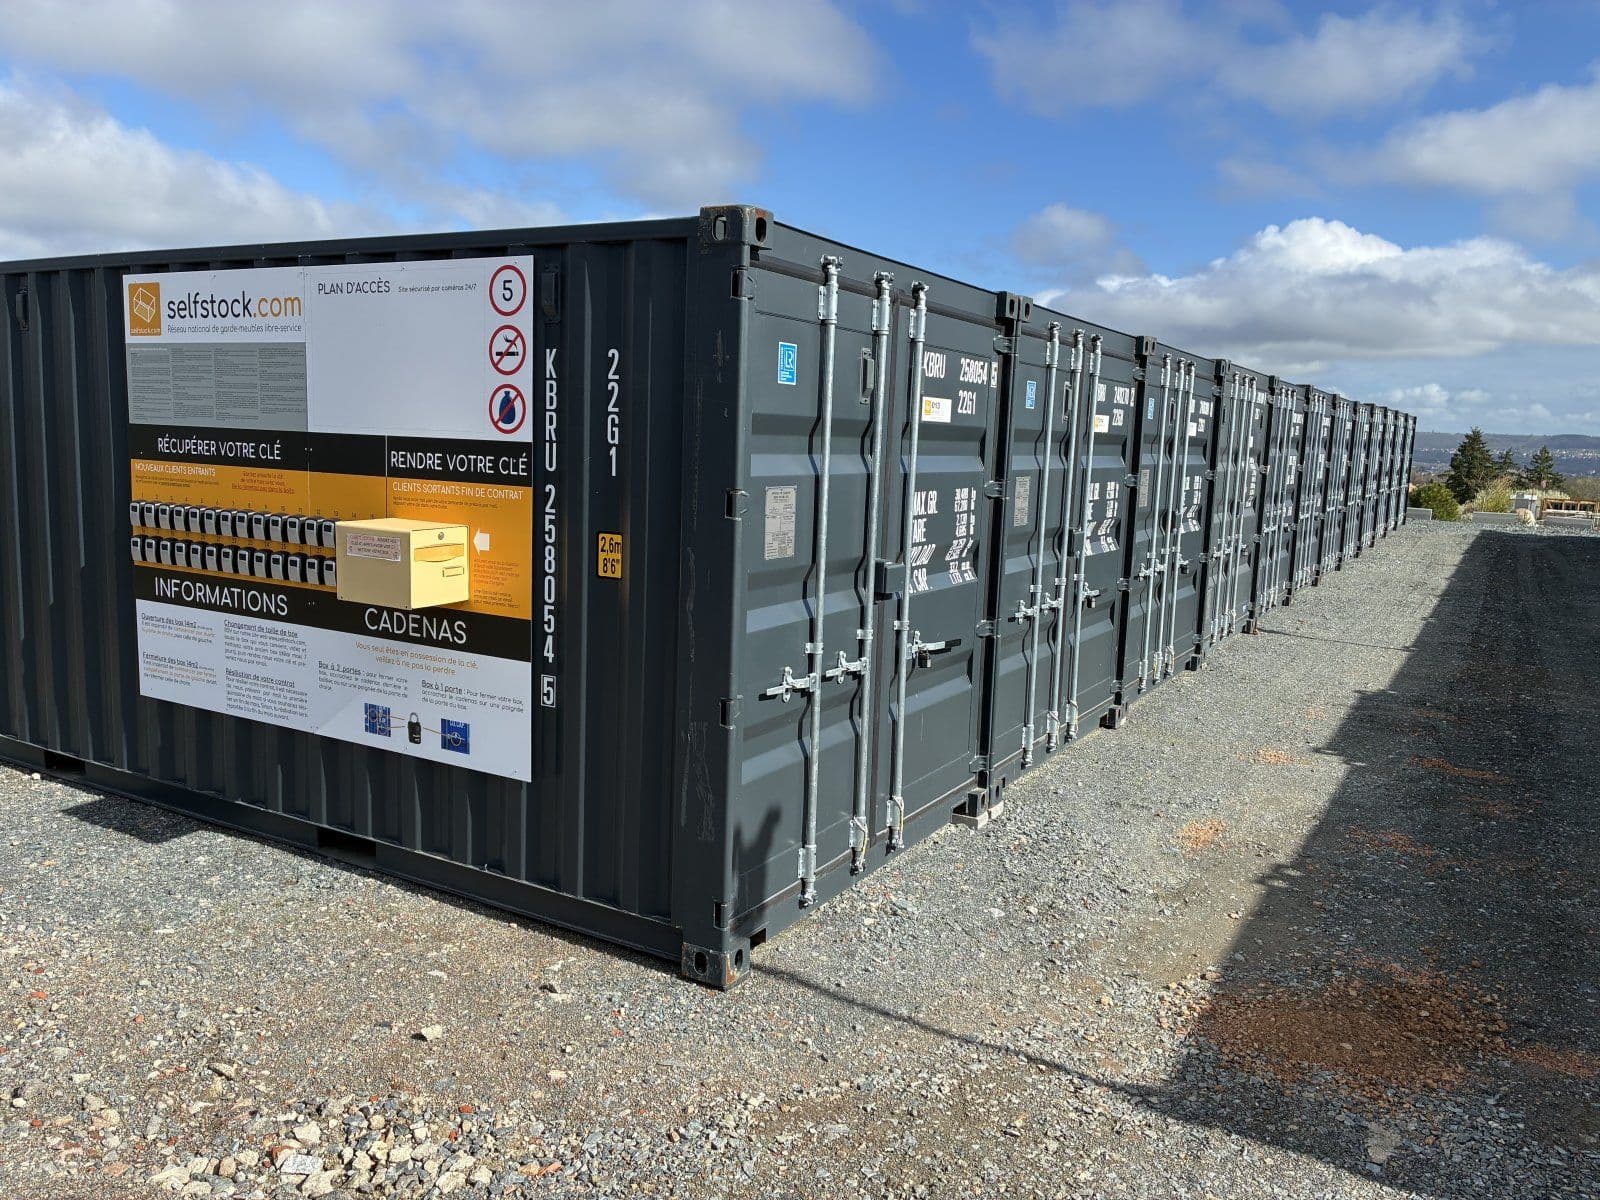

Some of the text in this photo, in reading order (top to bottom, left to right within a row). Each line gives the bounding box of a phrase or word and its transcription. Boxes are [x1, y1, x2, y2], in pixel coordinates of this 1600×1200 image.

[318, 277, 390, 294] PLAN D'ACCÈS
[502, 280, 513, 301] 5
[168, 291, 301, 319] selfstock.com
[168, 325, 186, 333] Réseau
[188, 325, 210, 333] national
[221, 324, 263, 334] garde-meubles
[960, 358, 988, 384] 258054
[608, 349, 619, 476] 22G1
[158, 434, 281, 459] RÉCUPÉRER VOTRE CLÉ
[136, 463, 215, 476] NOUVEAUX CLIENTS ENTRANTS
[391, 451, 527, 475] RENDRE VOTRE CLÉ
[393, 482, 523, 500] CLIENTS SORTANTS FIN DE CONTRAT
[543, 349, 557, 704] KBRU 258054 5
[913, 518, 927, 543] ARE
[601, 537, 621, 555] 2,6m
[155, 576, 288, 616] INFORMATIONS
[224, 619, 256, 631] Changement
[365, 608, 466, 644] CADENAS
[356, 641, 372, 650] Vous
[372, 645, 385, 654] seul
[386, 648, 400, 657] êtes
[410, 651, 446, 665] possession
[448, 656, 457, 666] de
[458, 658, 465, 667] la
[412, 662, 423, 671] pas
